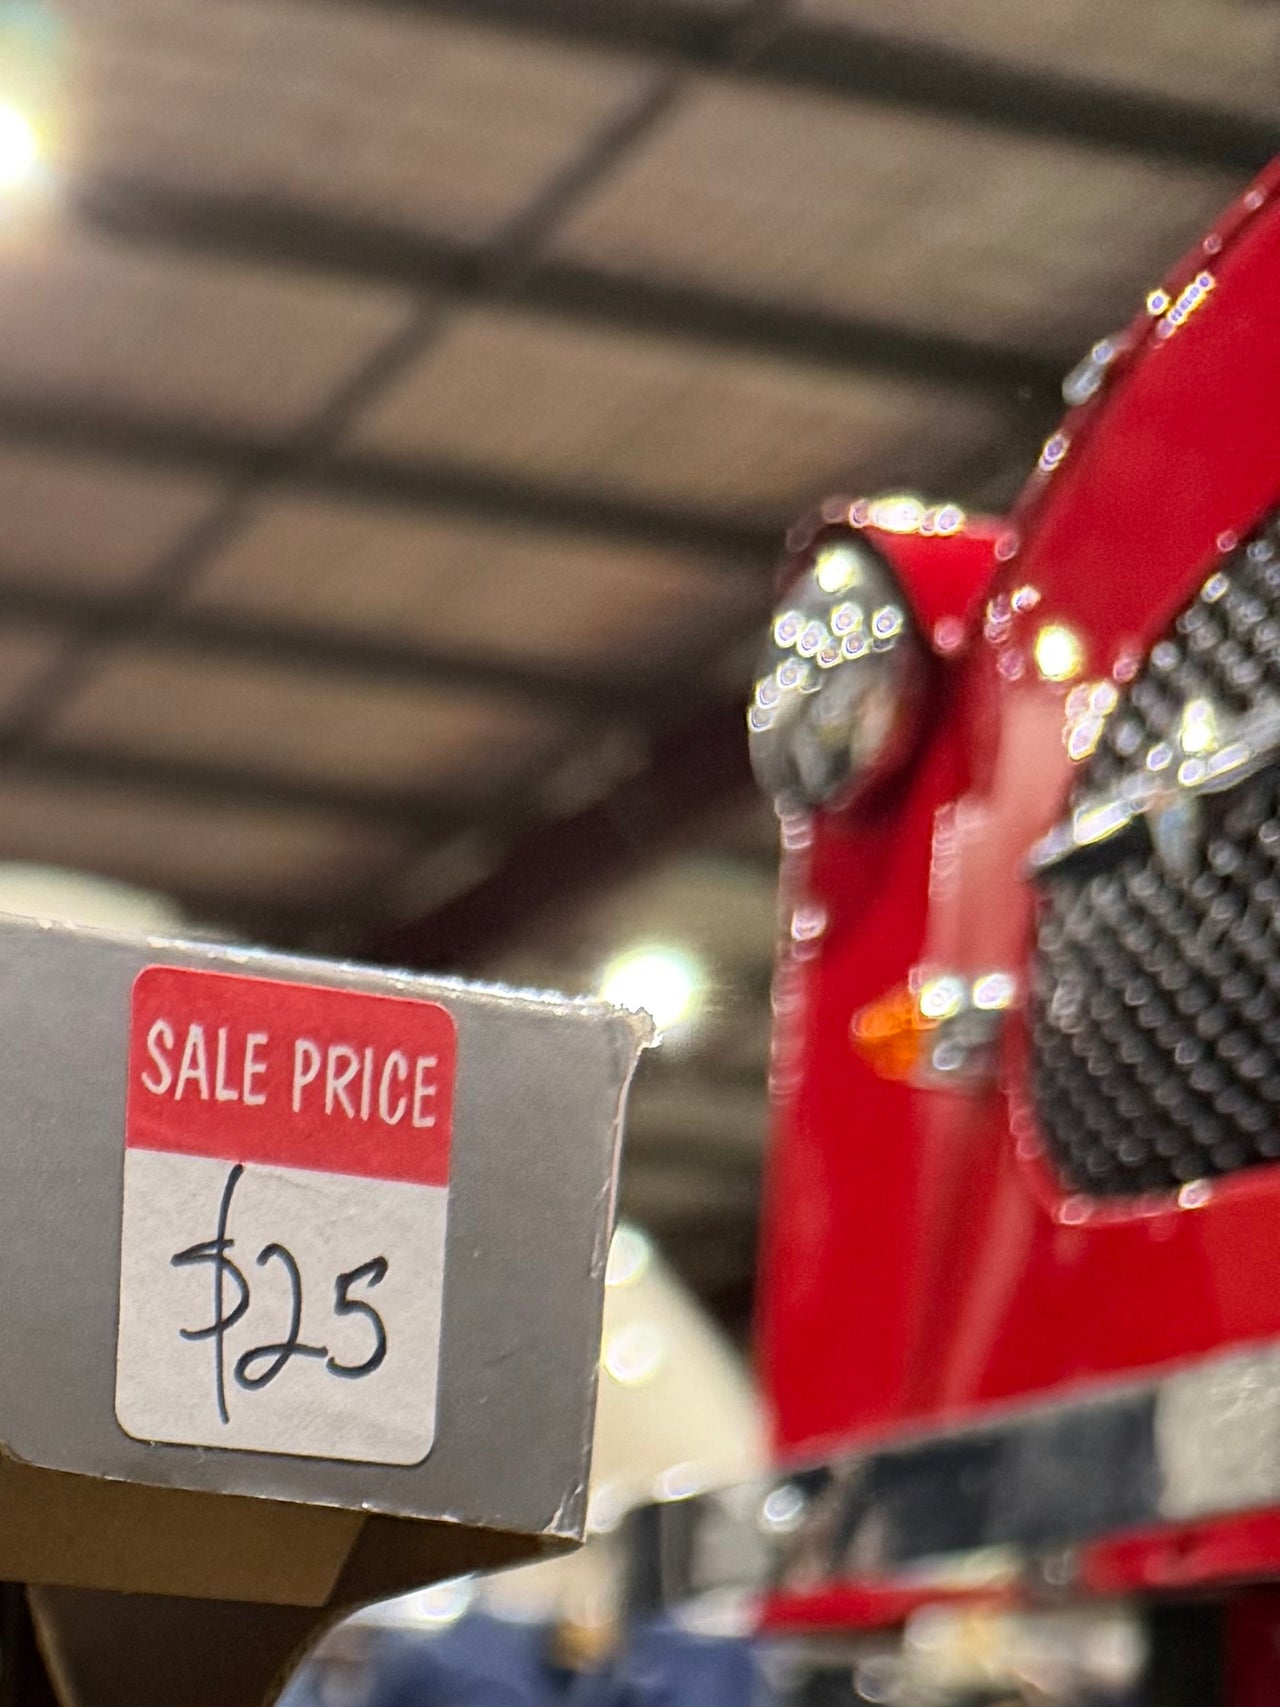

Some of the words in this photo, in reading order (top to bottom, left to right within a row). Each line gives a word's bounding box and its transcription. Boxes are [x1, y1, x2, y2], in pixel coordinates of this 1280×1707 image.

[141, 1018, 269, 1105] SALE
[292, 1037, 438, 1128] PRICE
[171, 1163, 389, 1425] $25
